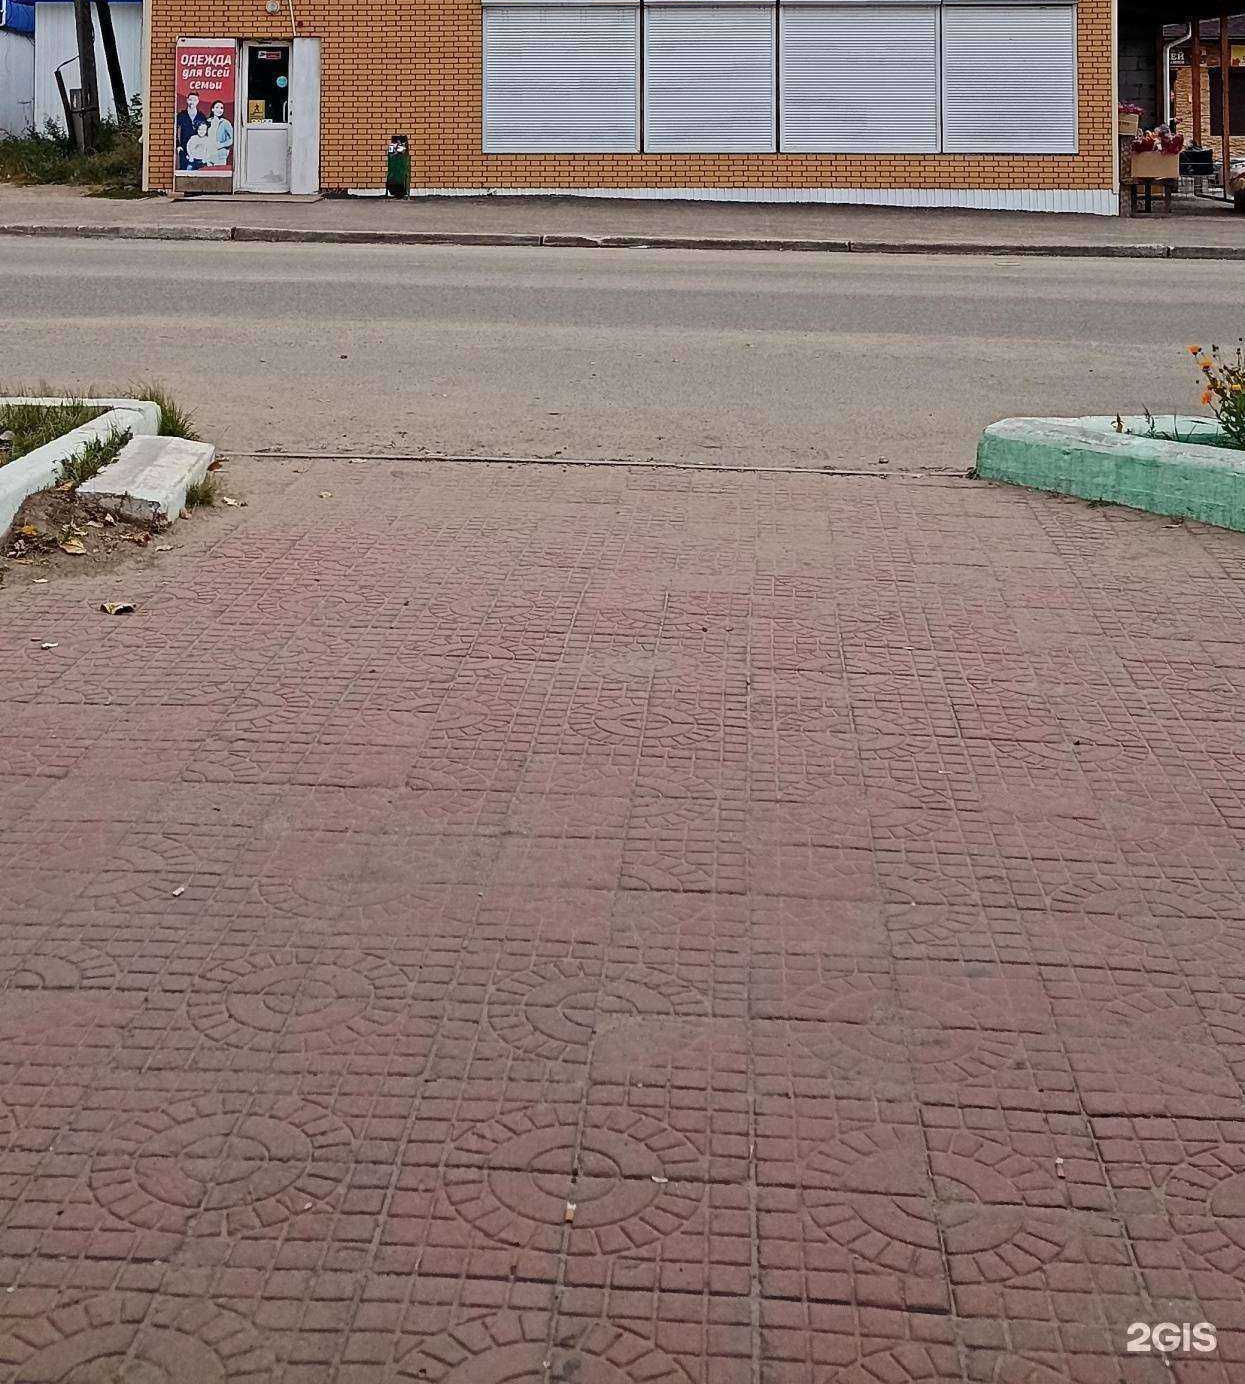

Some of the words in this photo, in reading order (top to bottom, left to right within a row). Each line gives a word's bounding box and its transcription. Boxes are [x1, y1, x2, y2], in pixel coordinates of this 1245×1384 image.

[180, 54, 231, 67] ОДЕЖДА
[182, 68, 203, 79] для
[205, 66, 230, 77] всей
[190, 80, 222, 90] семьи
